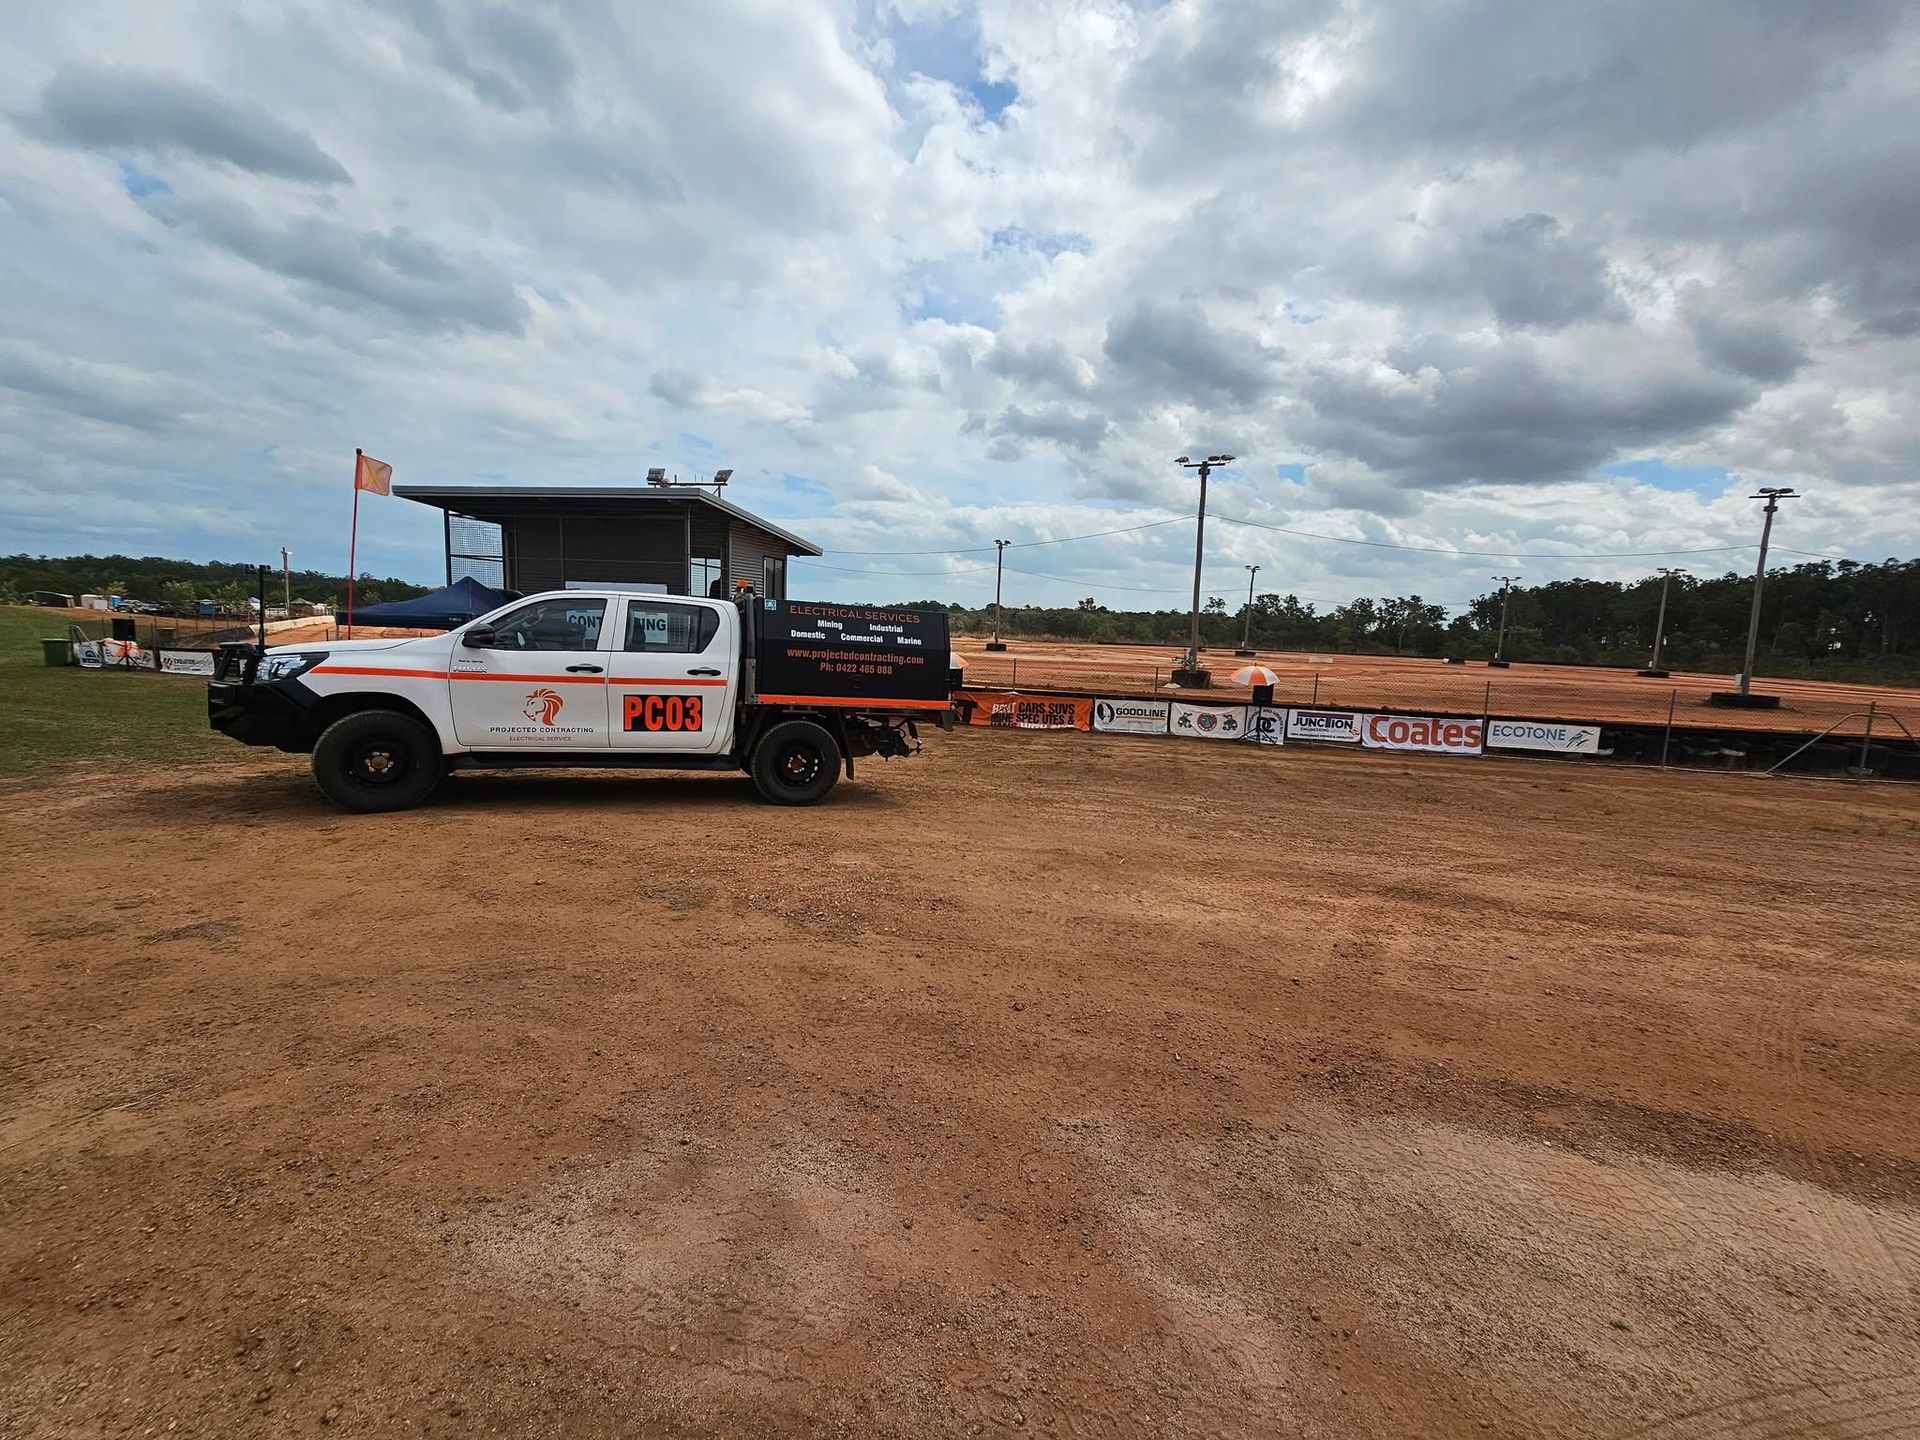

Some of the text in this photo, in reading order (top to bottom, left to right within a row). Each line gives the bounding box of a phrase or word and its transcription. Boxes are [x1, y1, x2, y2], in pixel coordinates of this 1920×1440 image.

[790, 605, 920, 623] ELECTRICAL SERVICES
[817, 620, 903, 633] Mining Industrial
[791, 629, 922, 645] Domestic Commercial Marine
[787, 648, 924, 665] www.projectedcontracting.com
[820, 662, 893, 675] Ph: 0422 465 088
[624, 696, 701, 731] PC03
[1019, 702, 1045, 714] CARS
[1048, 703, 1075, 715] SUVS
[1116, 708, 1166, 717] GOODLINE
[1016, 713, 1039, 725] SPEC
[1042, 714, 1065, 725] UTES
[1293, 712, 1354, 729] JUNCTION
[1369, 715, 1481, 747] Coates
[1492, 725, 1567, 740] ECOTONE
